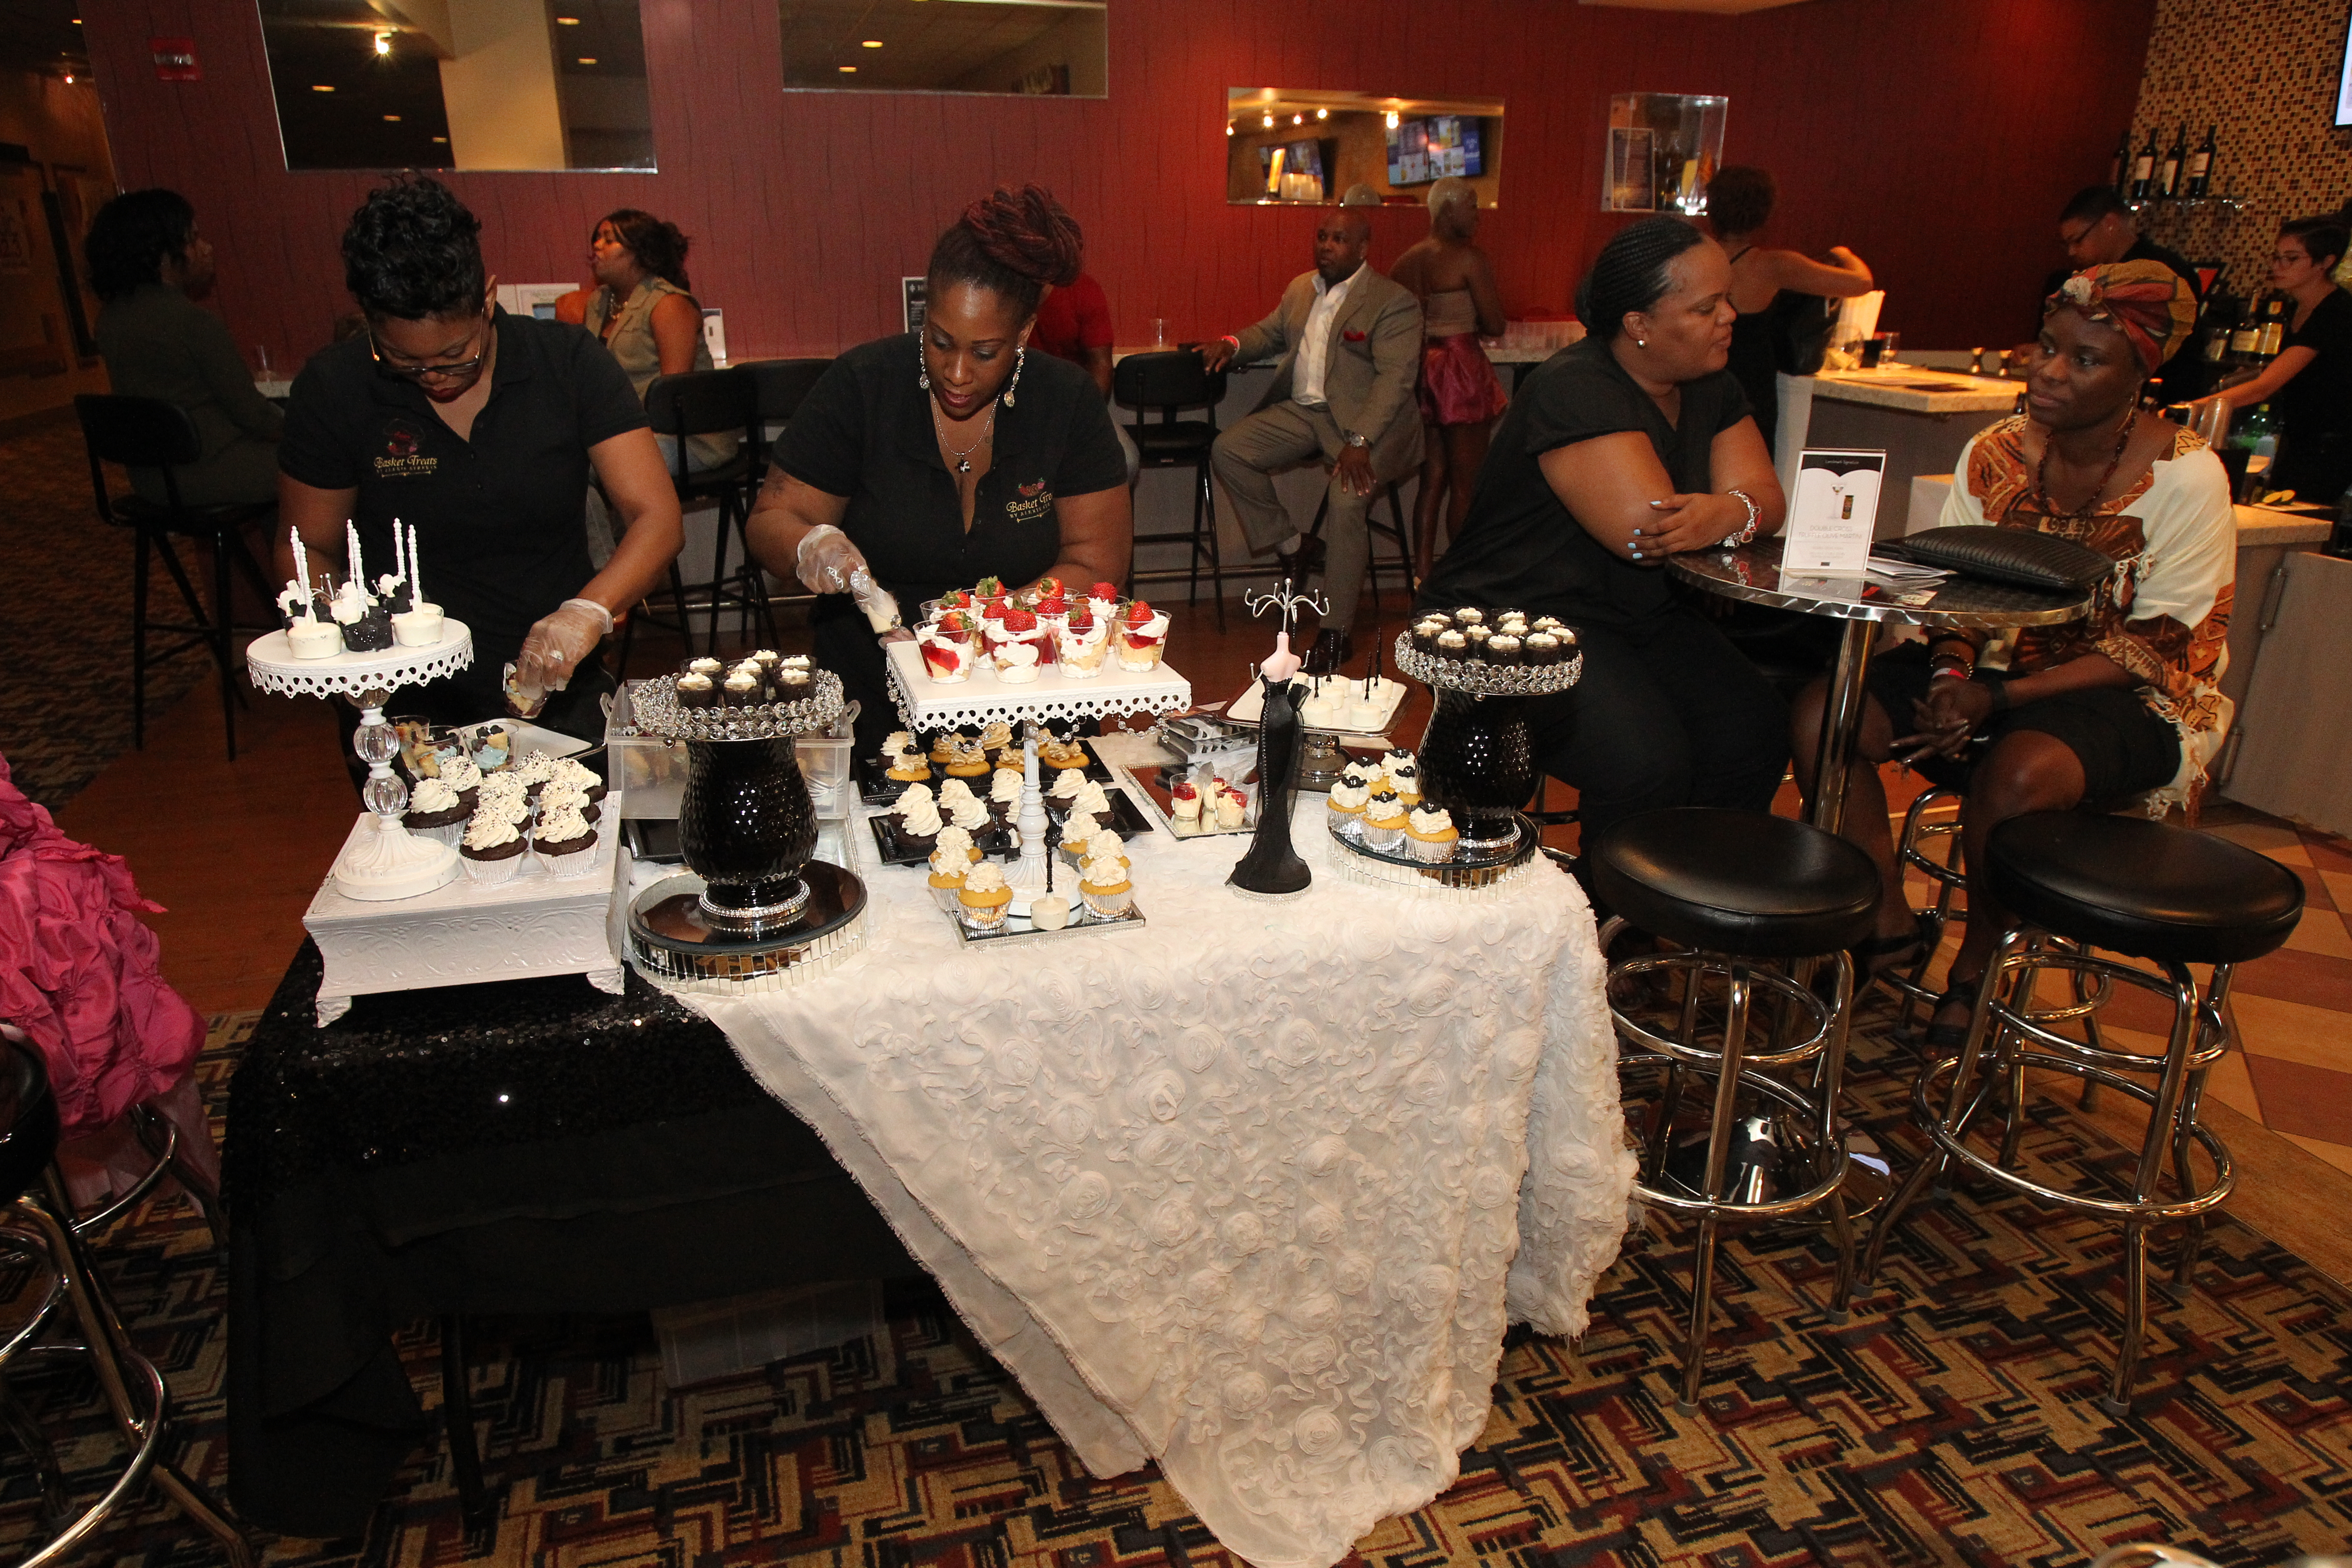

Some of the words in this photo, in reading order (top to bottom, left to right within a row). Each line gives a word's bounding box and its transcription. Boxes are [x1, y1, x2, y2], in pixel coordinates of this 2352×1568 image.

[374, 457, 404, 469] Basket
[407, 455, 438, 466] Treats
[1006, 499, 1038, 513] Basket
[1020, 506, 1041, 516] ALEXIS
